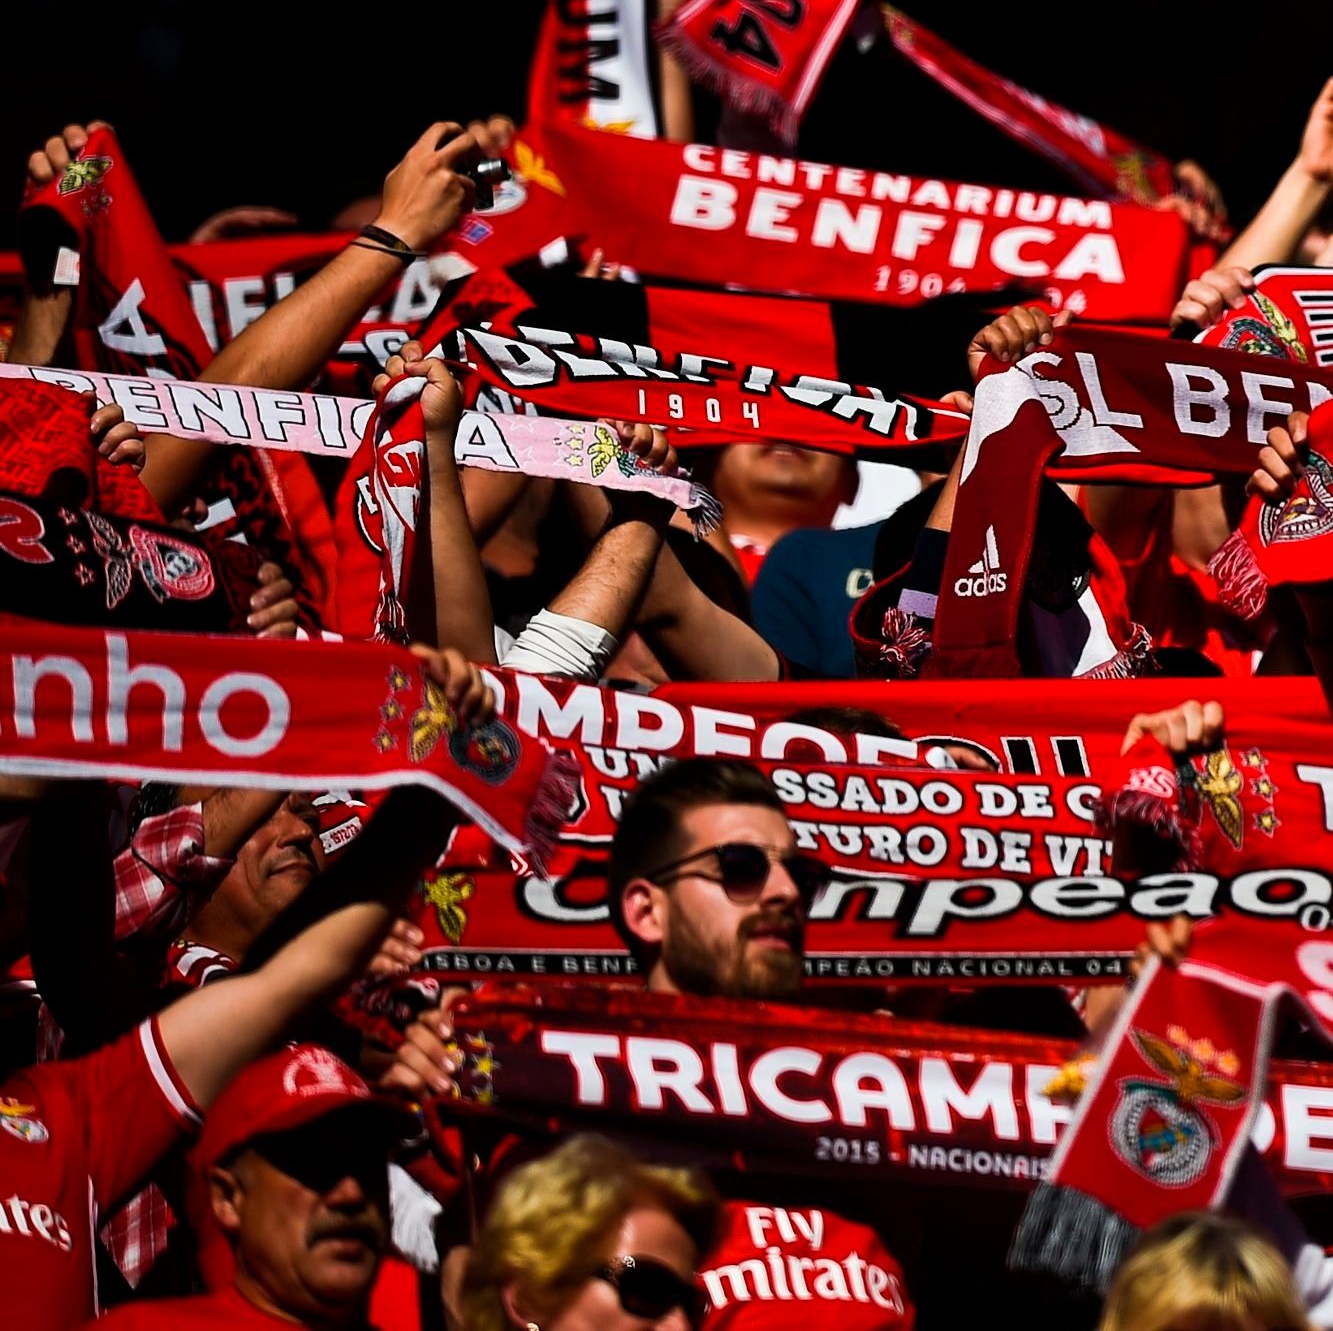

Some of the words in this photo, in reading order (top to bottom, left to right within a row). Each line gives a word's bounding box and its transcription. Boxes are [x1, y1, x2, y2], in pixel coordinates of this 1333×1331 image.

[683, 144, 1112, 230] CENTENARIUM
[669, 174, 1125, 284] BENFICA
[637, 388, 760, 430] 1904
[1018, 351, 1143, 431] SL
[11, 632, 291, 758] nho
[771, 768, 963, 816] SSADO
[974, 783, 1055, 818] DE
[788, 820, 948, 867] TURO
[960, 826, 1032, 875] DE
[531, 955, 547, 973] E
[912, 959, 1073, 977] NACIONAL
[816, 1135, 880, 1163] 2015
[745, 1205, 825, 1253] Fly
[701, 1247, 903, 1317] mirates
